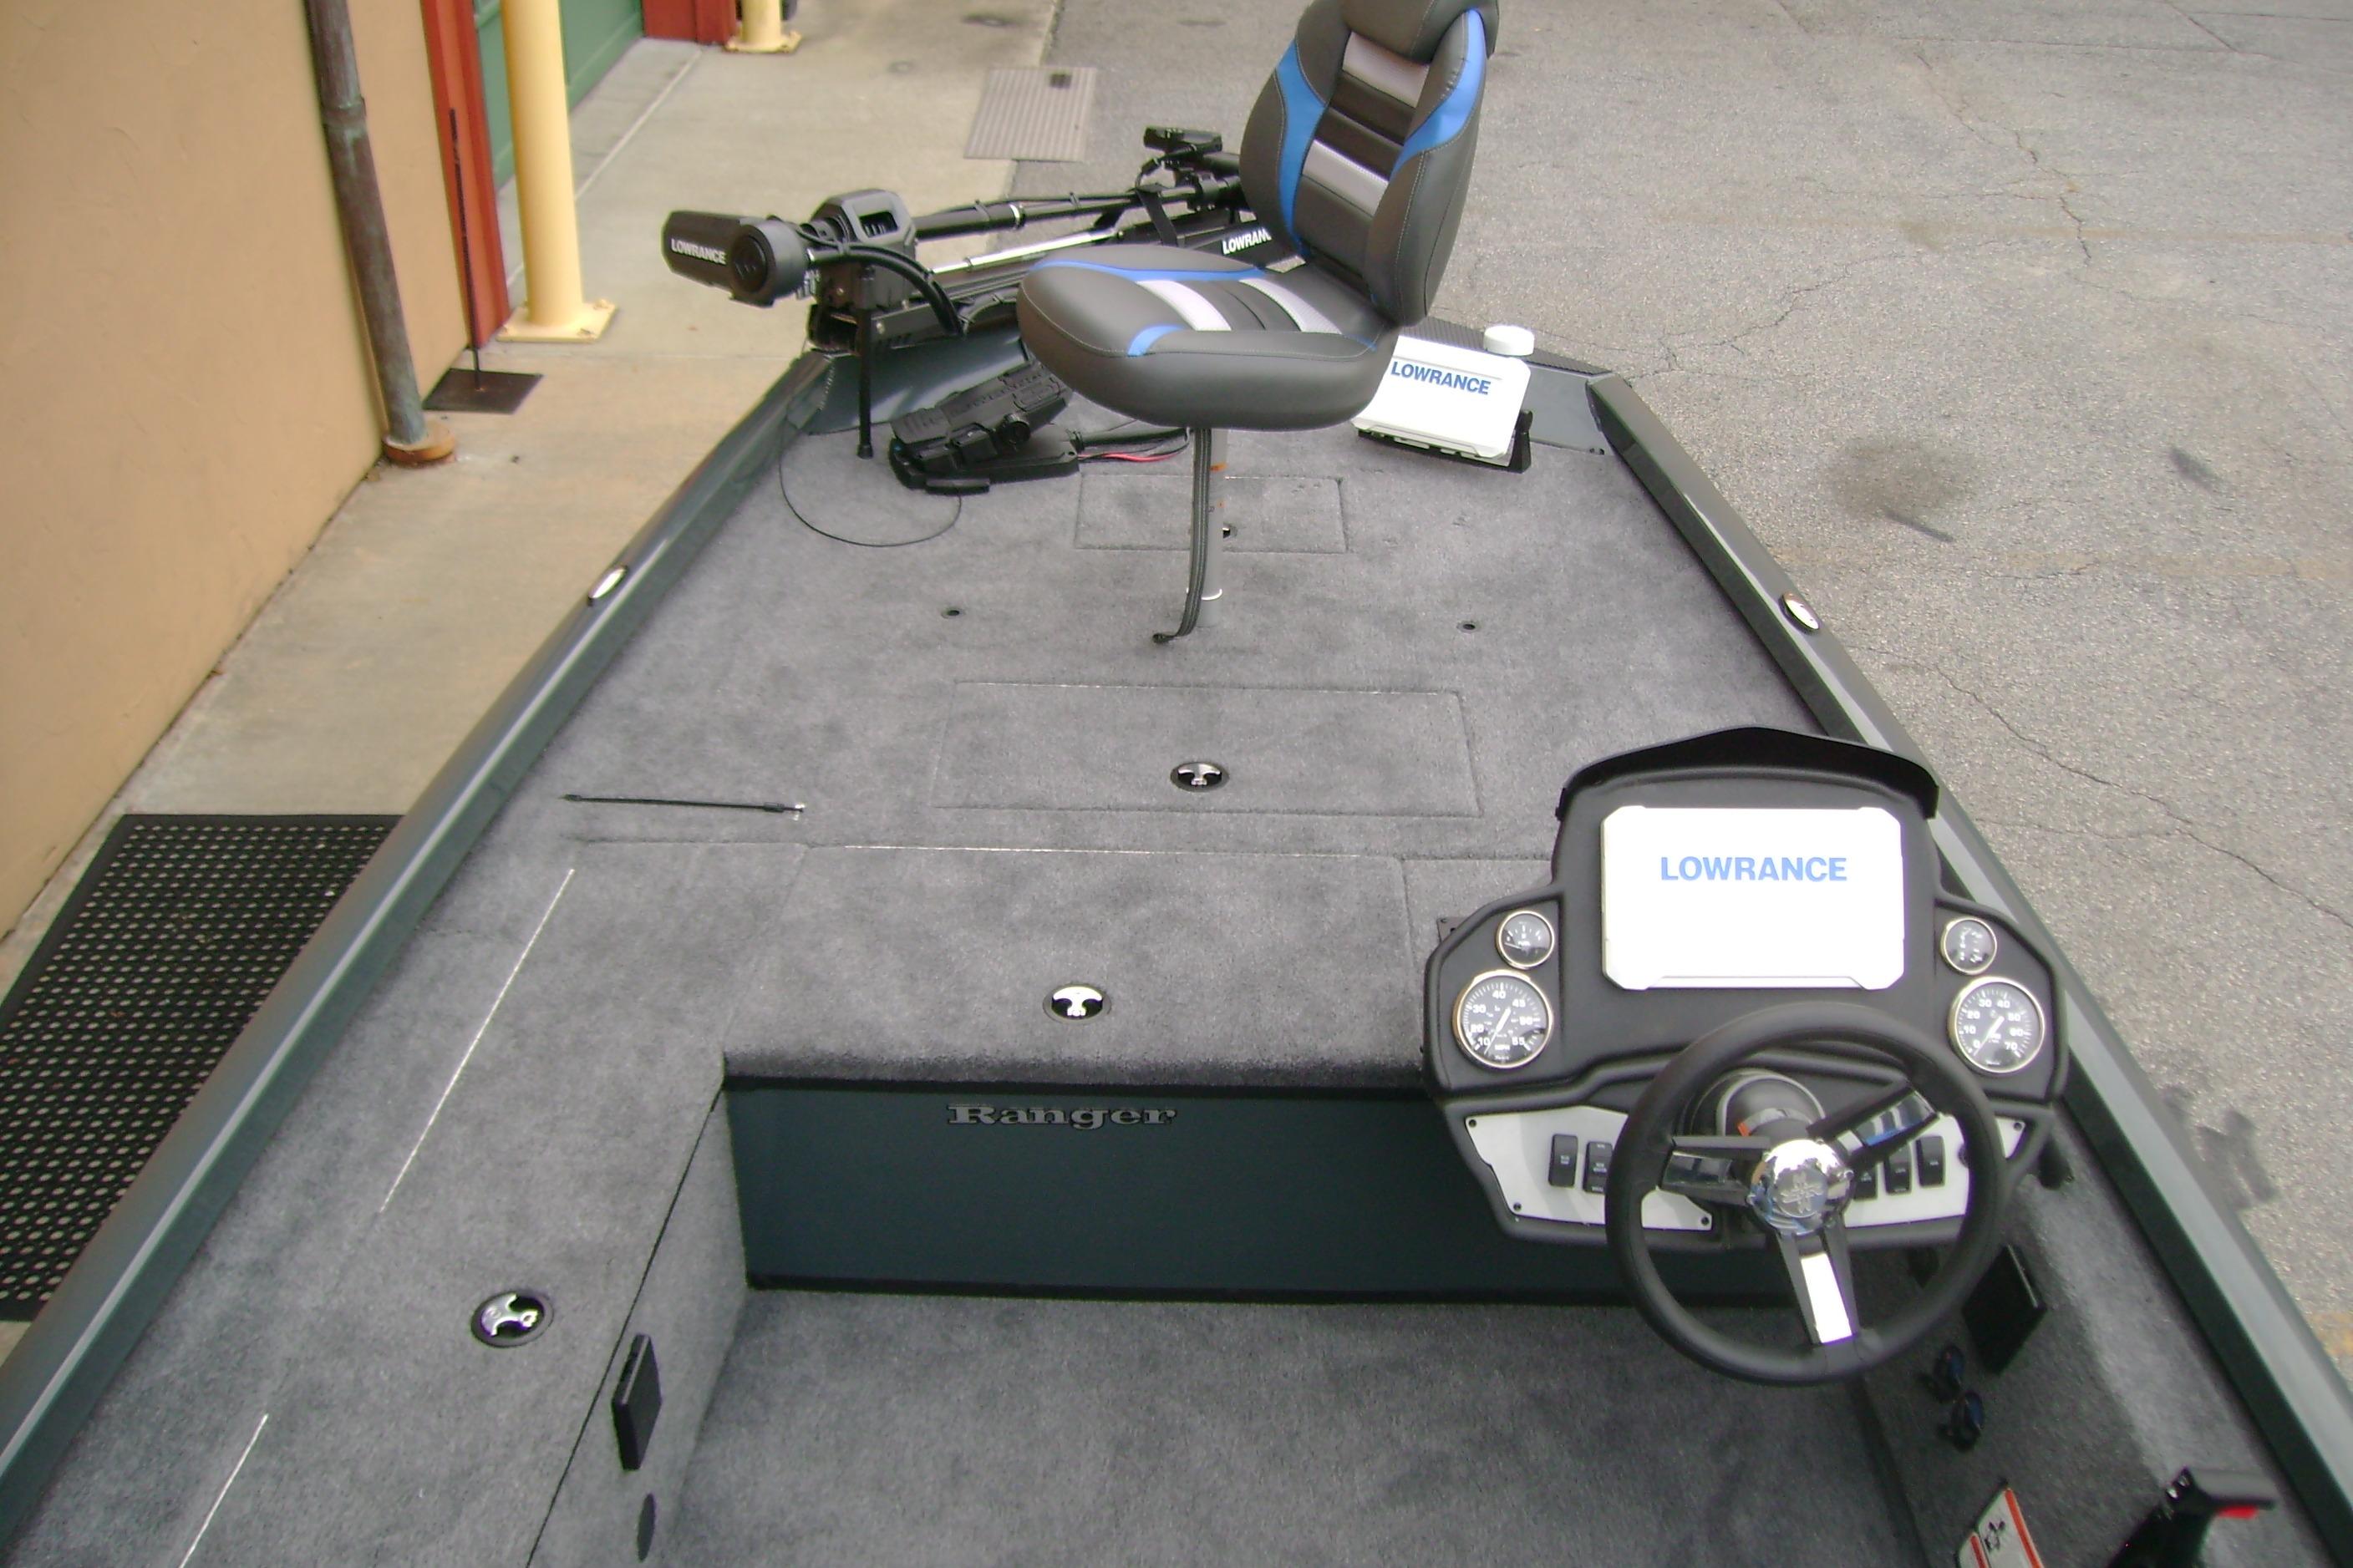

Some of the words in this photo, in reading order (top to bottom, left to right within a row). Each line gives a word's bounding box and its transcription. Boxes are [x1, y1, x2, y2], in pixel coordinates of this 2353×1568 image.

[671, 238, 726, 265] LOWRANCE
[1391, 361, 1492, 395] LOWRANCE
[1660, 856, 1847, 882] LOWRANCE
[1492, 990, 1507, 999] 40
[1512, 999, 1527, 1007] 45
[1979, 998, 1992, 1007] 30
[1996, 1000, 2010, 1008] 40
[1472, 1004, 1487, 1013] 30
[1967, 1010, 1980, 1019] 20
[1963, 1025, 1976, 1034] 10
[1477, 1037, 1491, 1046] 10
[2004, 1042, 2018, 1050] 70
[948, 1104, 1176, 1130] Ranger
